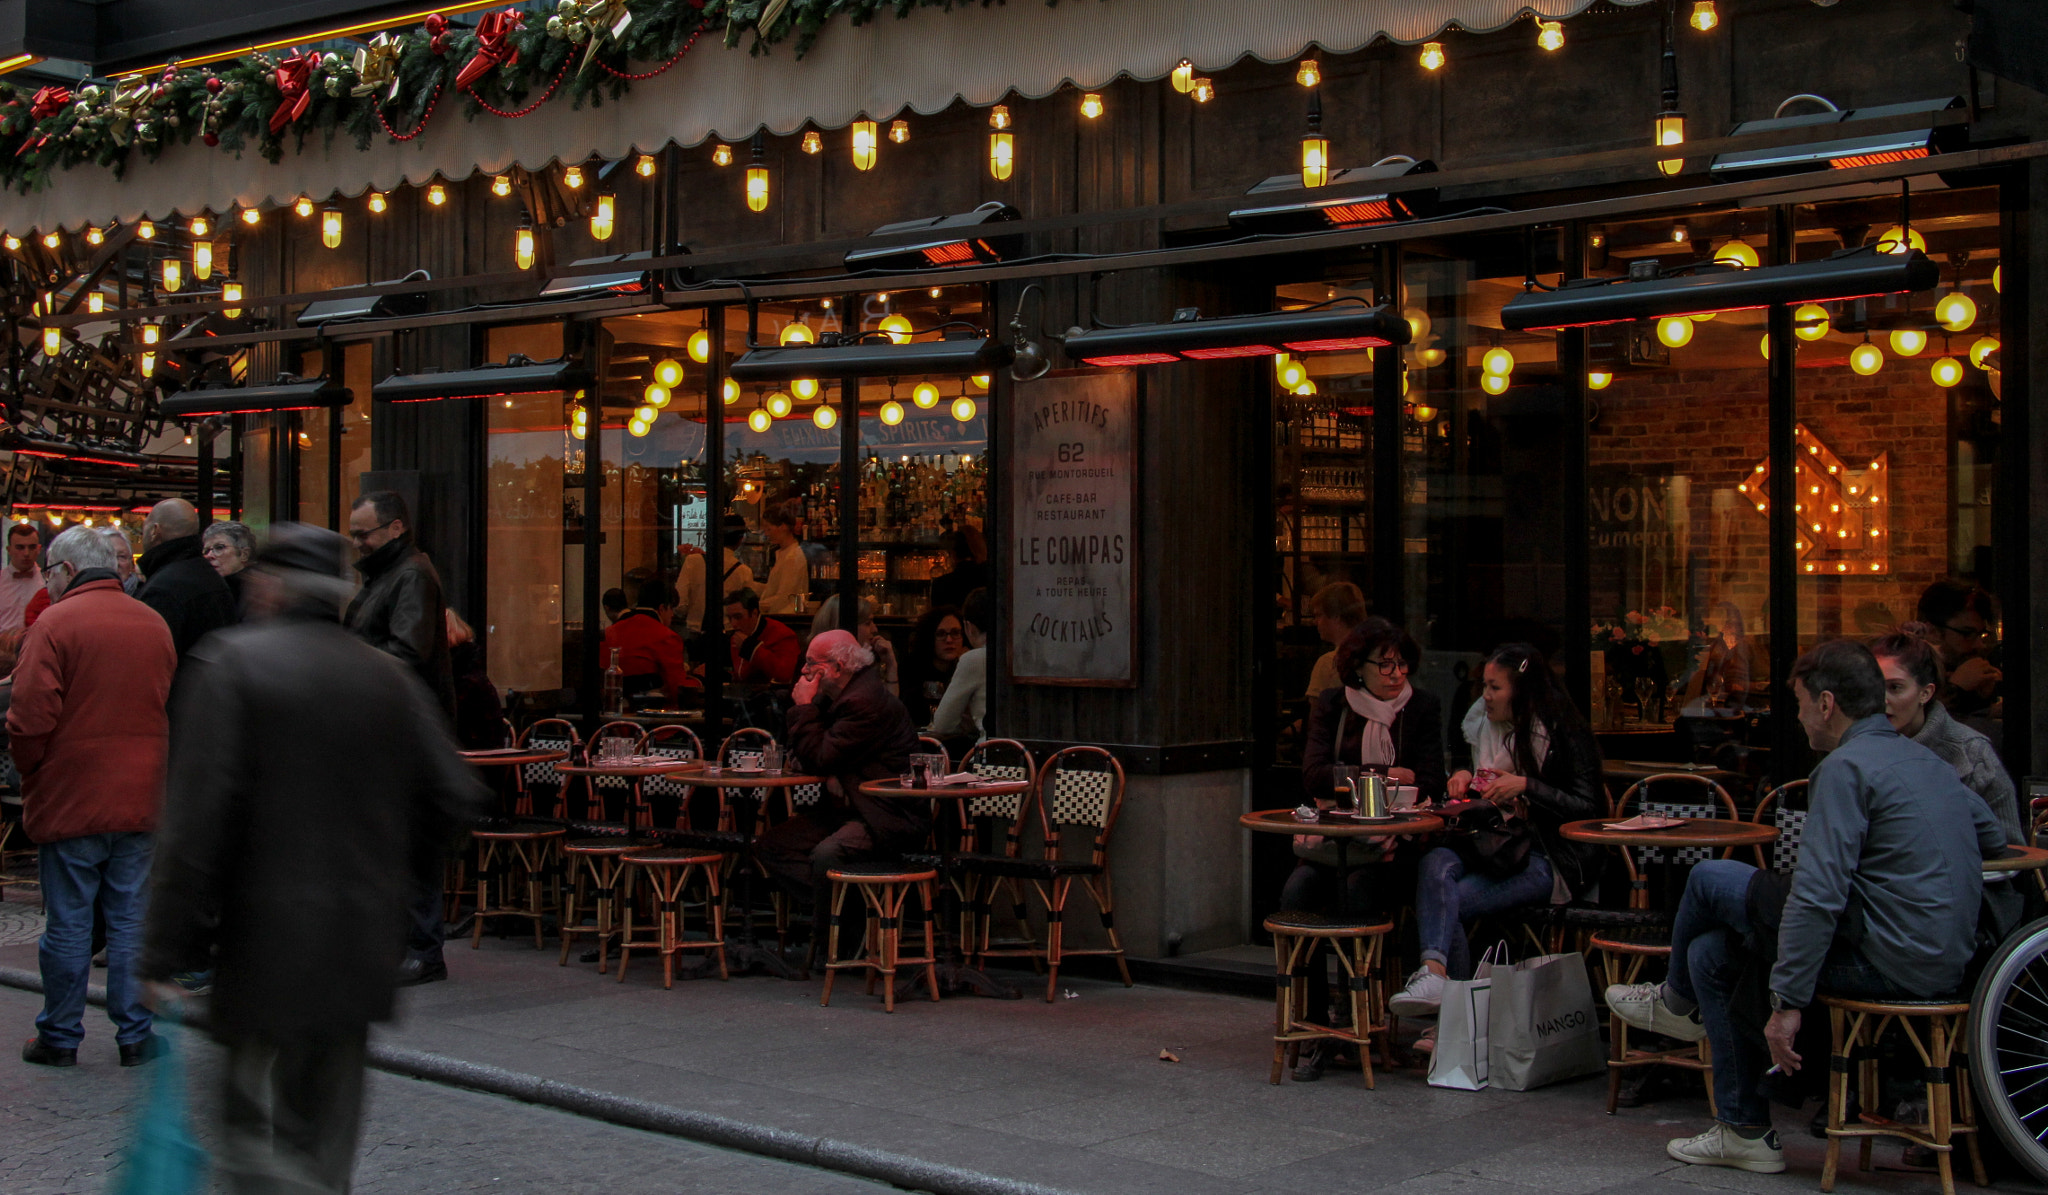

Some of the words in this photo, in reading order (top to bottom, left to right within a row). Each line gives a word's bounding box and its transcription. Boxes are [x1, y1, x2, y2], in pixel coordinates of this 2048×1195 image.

[1033, 400, 1109, 432] APERITIFS
[878, 419, 940, 443] SPIRITS
[1058, 442, 1084, 462] 62
[1029, 470, 1045, 480] RUE
[1049, 467, 1114, 479] MONTORGUEIL
[1046, 493, 1097, 504] CAFE-BAR
[1037, 509, 1106, 520] RESTAURANT
[1020, 537, 1039, 565] LE
[1047, 534, 1124, 565] COMPAS
[1056, 577, 1086, 586] REPAS
[1046, 588, 1073, 597] TOUTE
[1078, 587, 1107, 597] HEURE
[1030, 612, 1113, 642] COCKTAILS
[1536, 1010, 1586, 1038] MANGO
